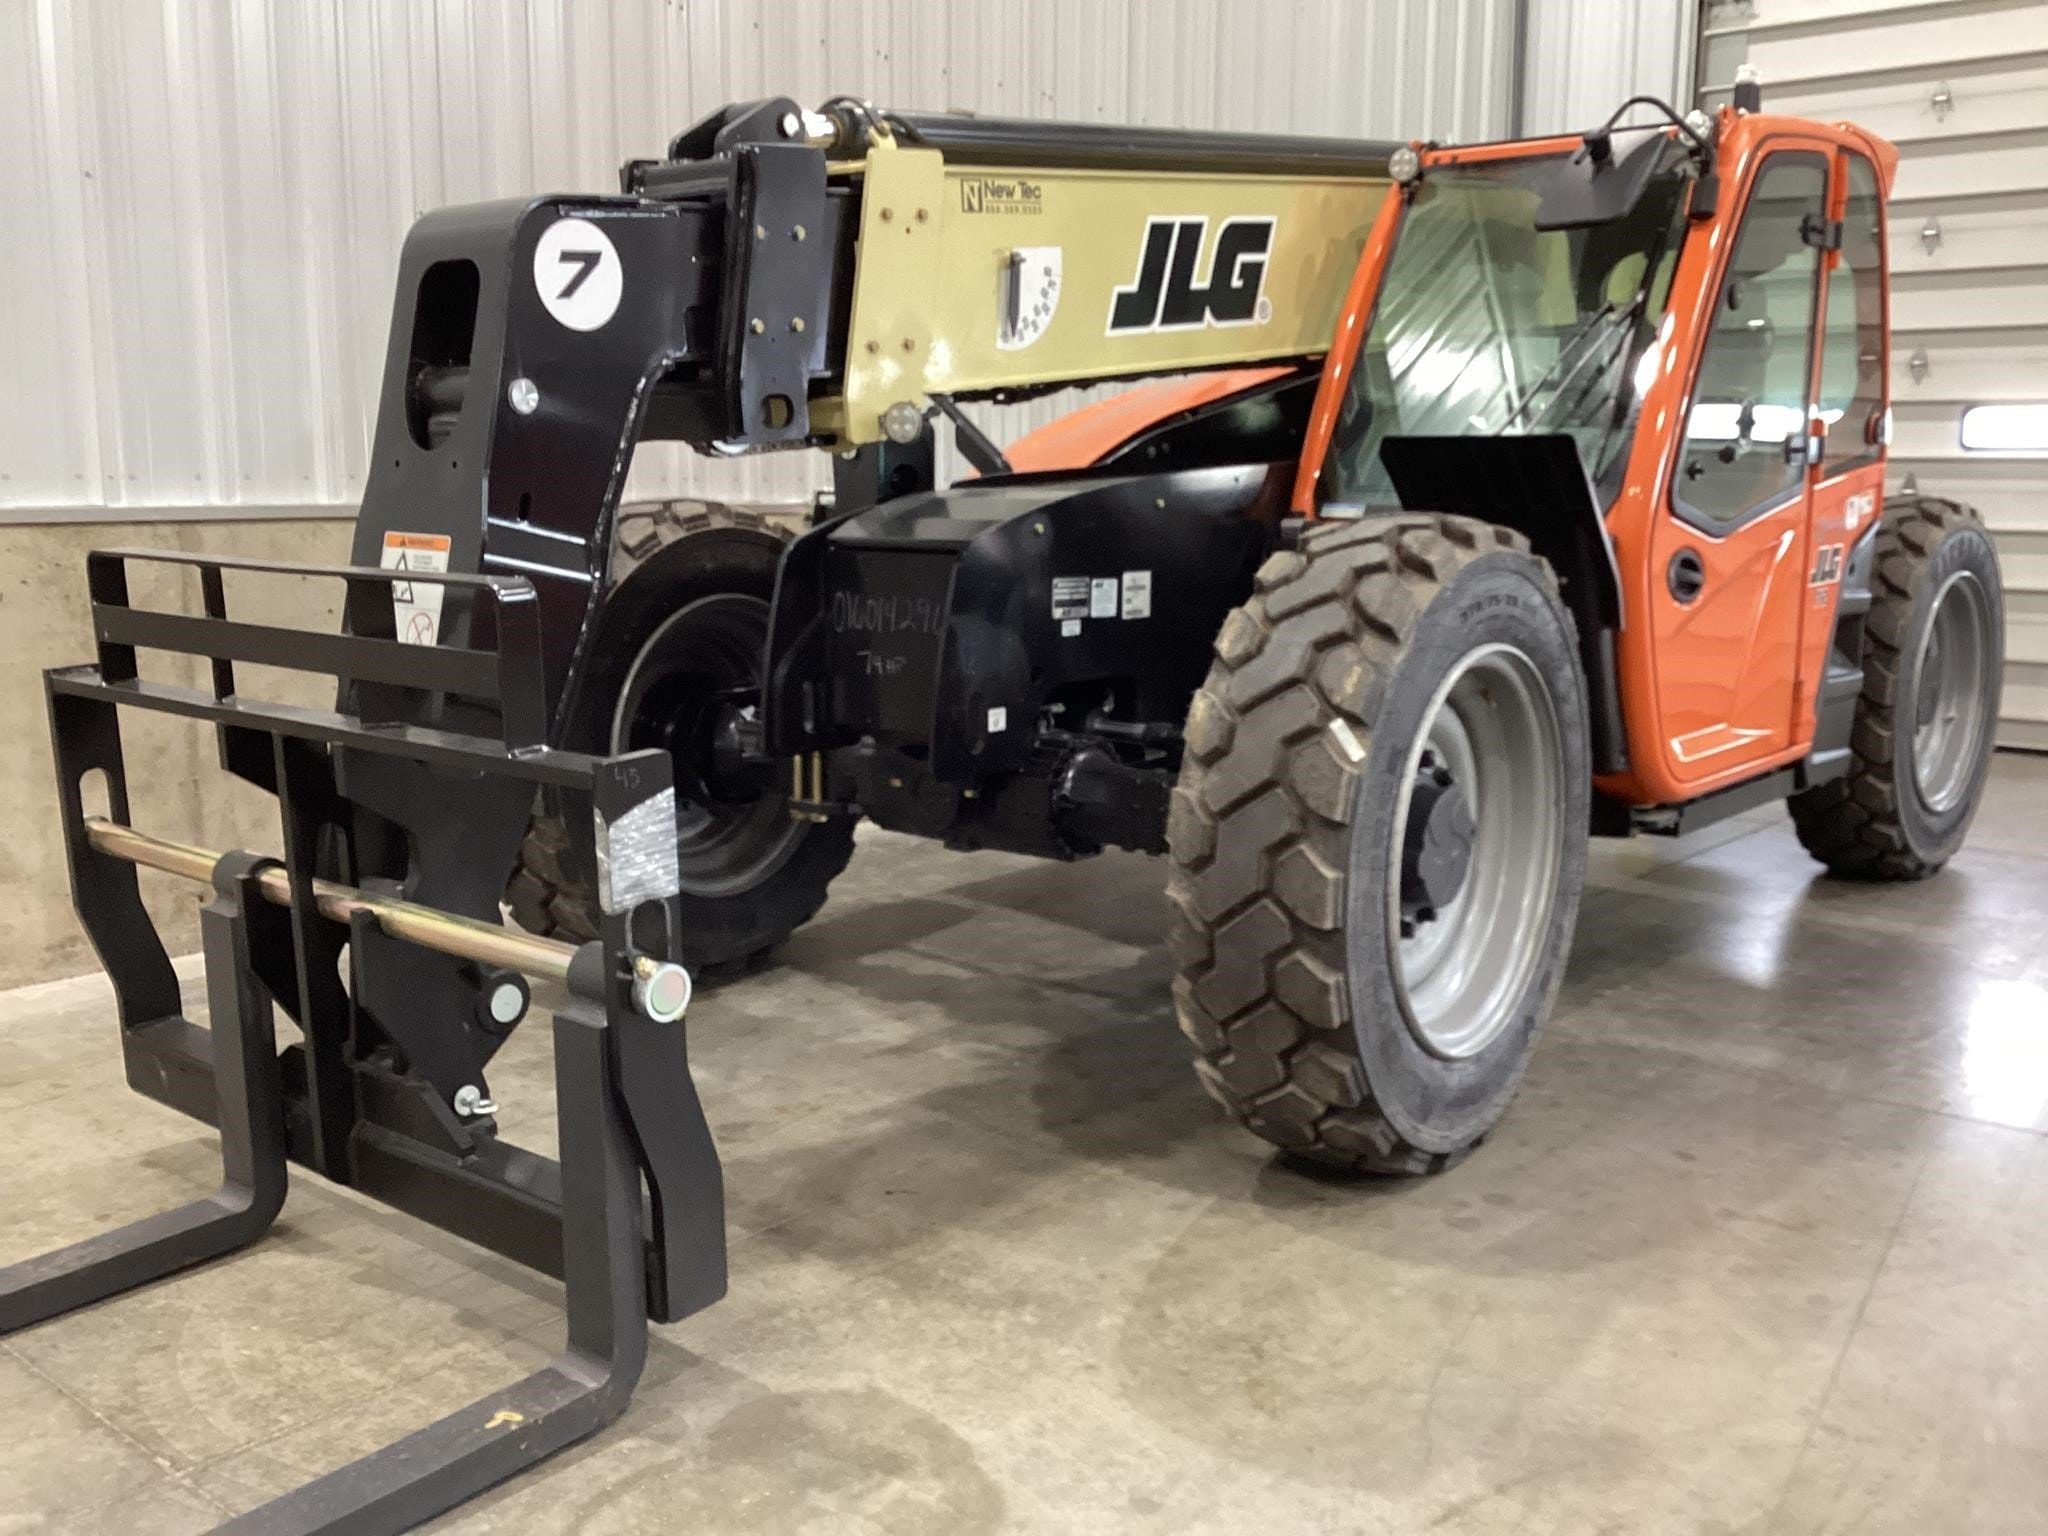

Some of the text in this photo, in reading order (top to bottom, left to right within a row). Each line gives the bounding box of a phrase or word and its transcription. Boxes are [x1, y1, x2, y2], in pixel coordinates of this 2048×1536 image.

[983, 179, 1042, 200] New Tec
[556, 249, 602, 299] 7
[1107, 217, 1276, 335] JLG
[1808, 543, 1844, 587] JLG
